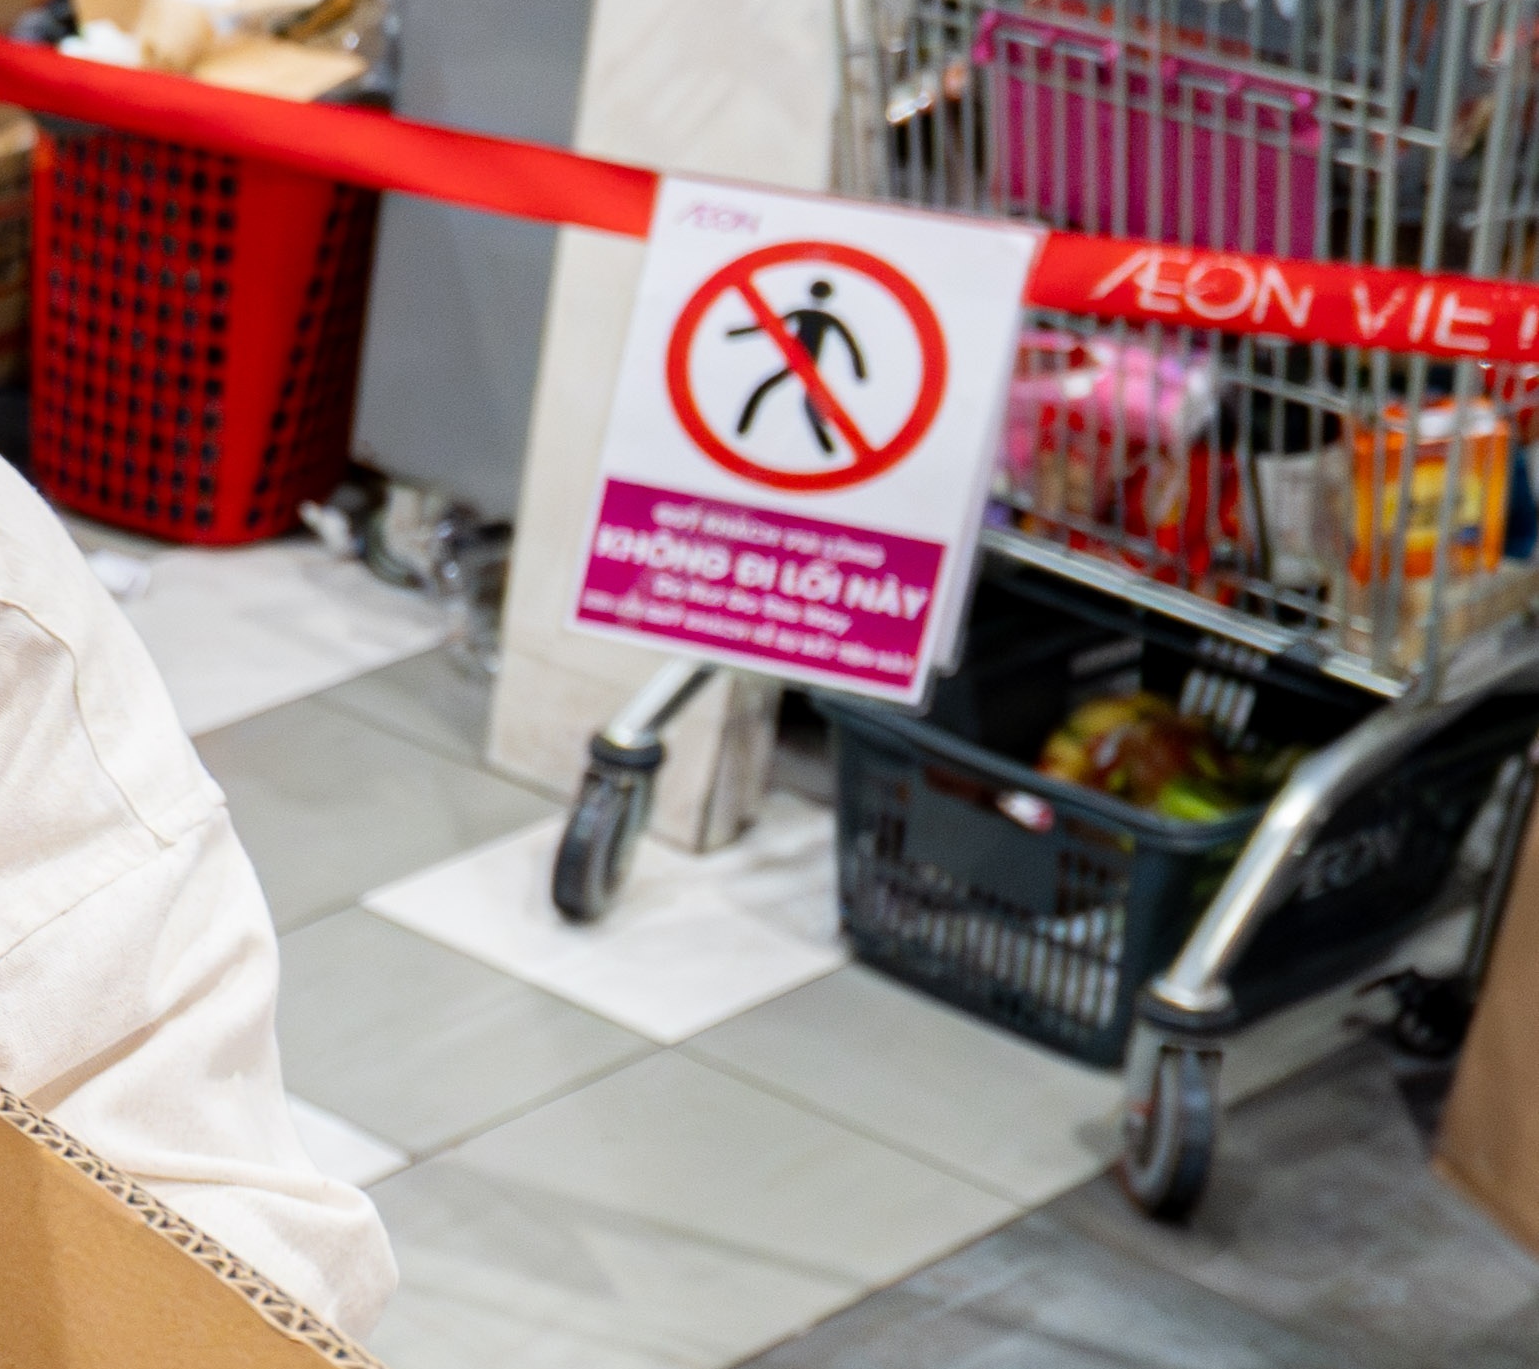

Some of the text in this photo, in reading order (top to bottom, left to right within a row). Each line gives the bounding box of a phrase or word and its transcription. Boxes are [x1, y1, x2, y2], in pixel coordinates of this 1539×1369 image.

[1089, 246, 1316, 329] ÆON
[593, 518, 735, 583] KHÔNG
[842, 568, 932, 622] NÀY
